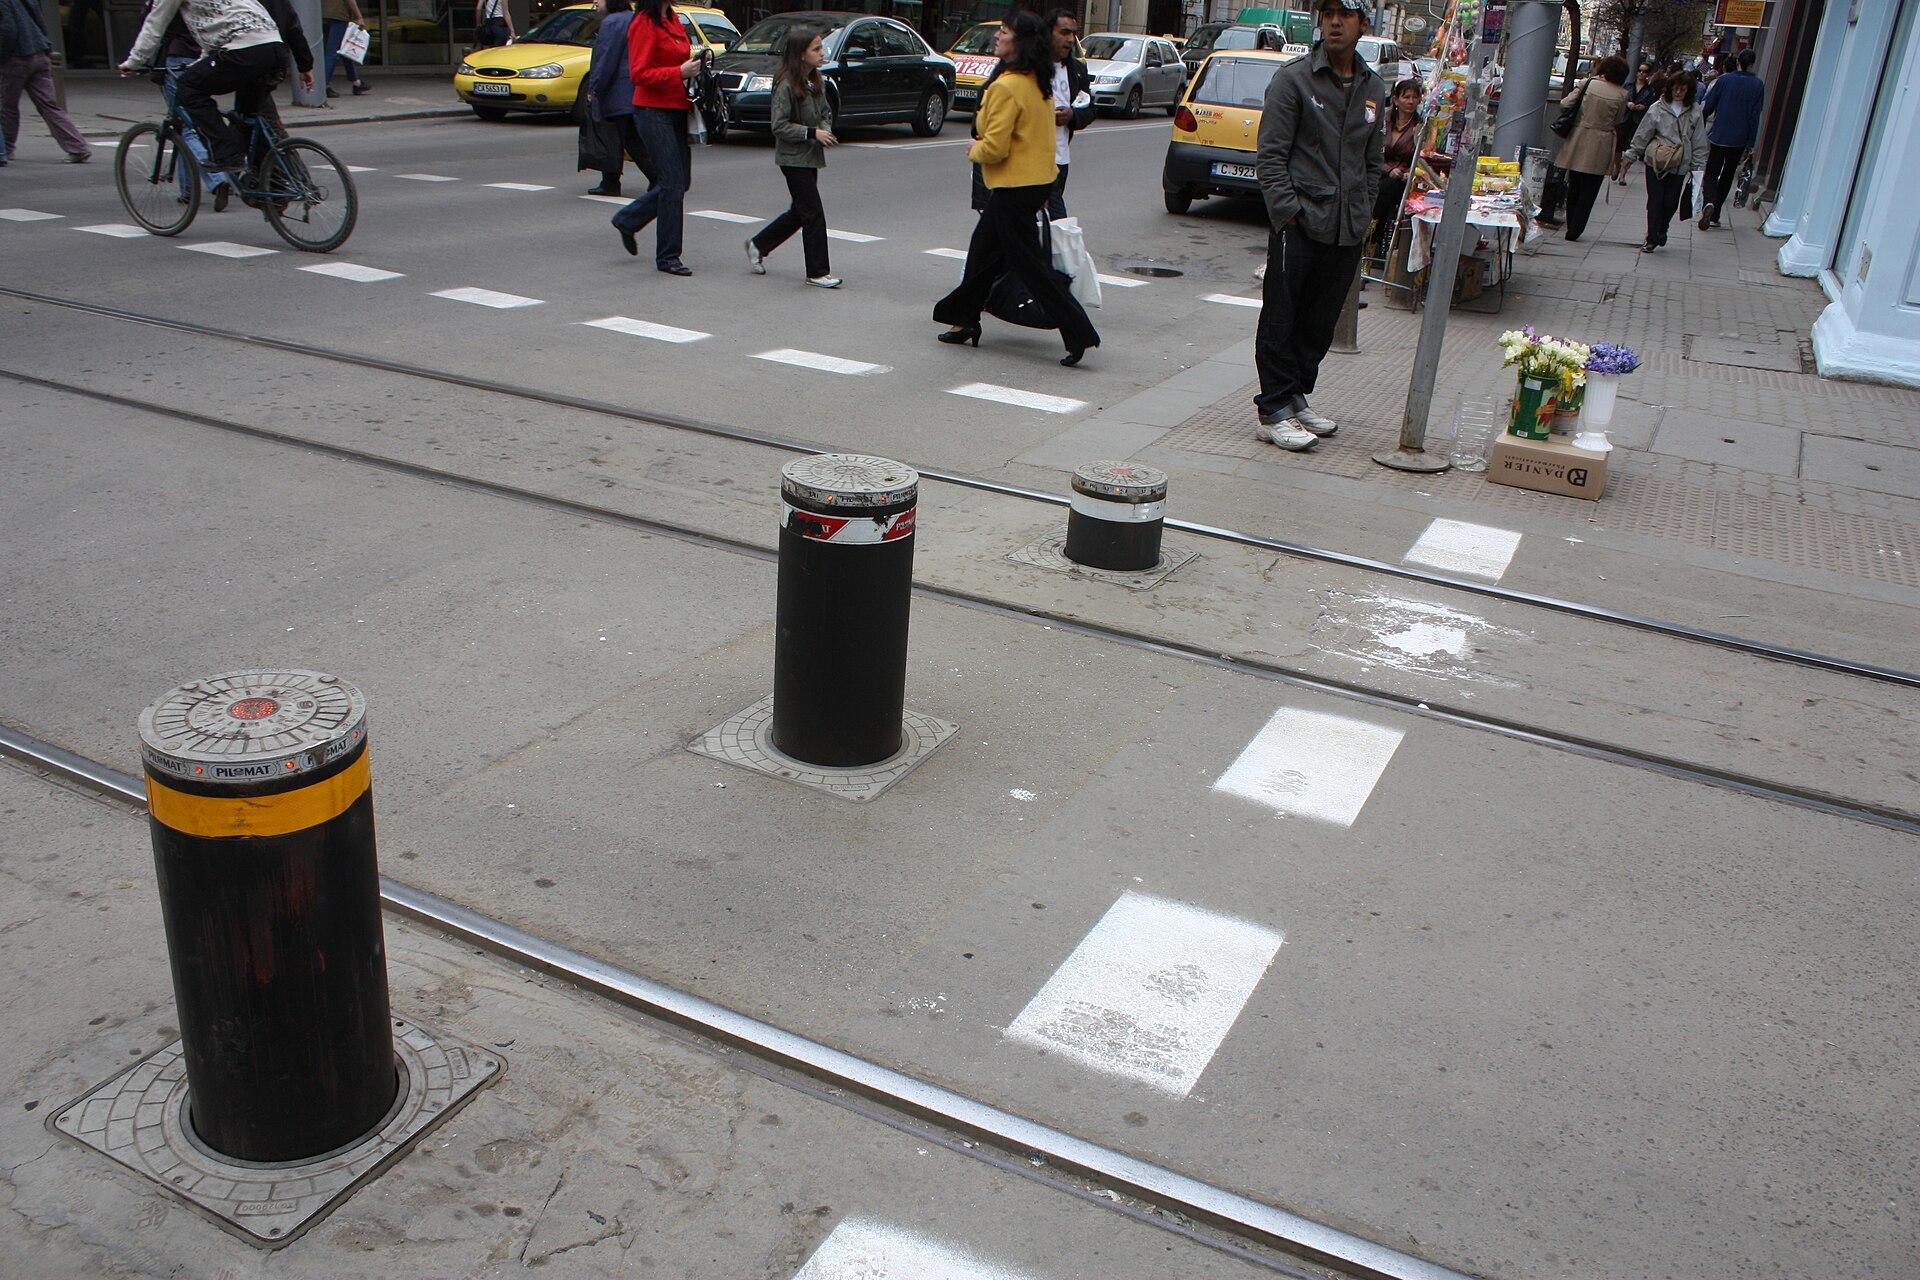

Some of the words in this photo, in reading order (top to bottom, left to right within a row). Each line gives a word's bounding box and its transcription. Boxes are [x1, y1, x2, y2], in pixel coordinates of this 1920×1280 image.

[1286, 45, 1306, 53] ТАКСИ
[955, 61, 996, 76] 91280
[1504, 461, 1565, 479] DANIER
[307, 739, 348, 765] PMAT
[148, 751, 182, 773] PILOMAT
[215, 764, 271, 778] PILOMAT
